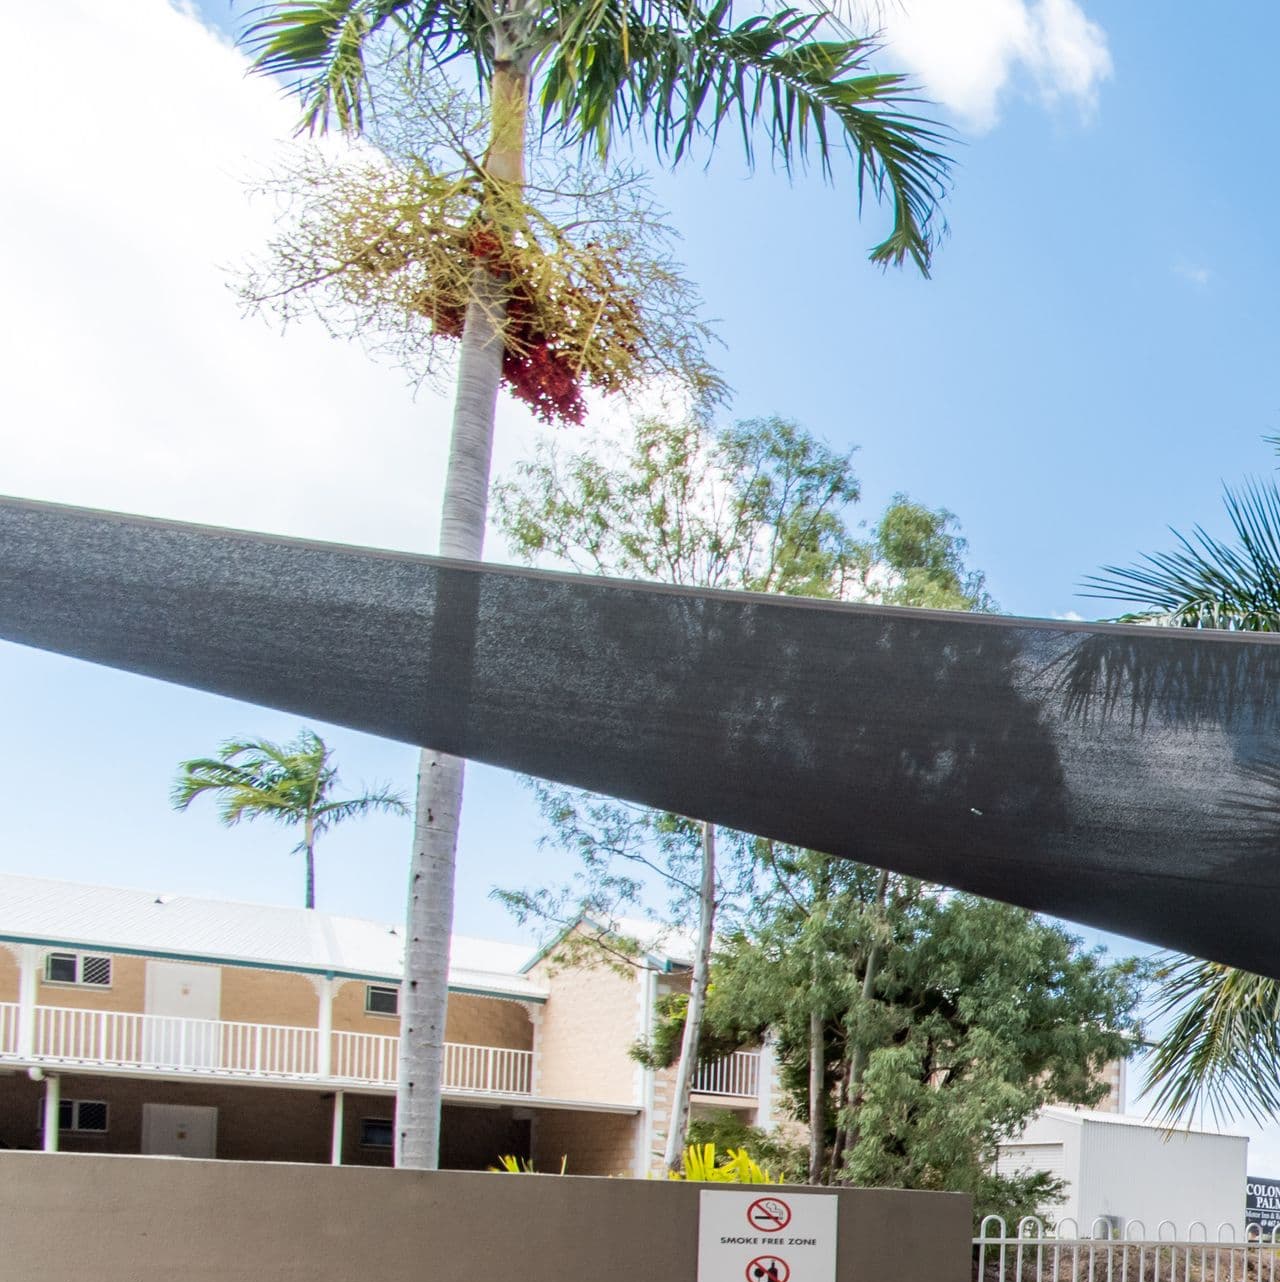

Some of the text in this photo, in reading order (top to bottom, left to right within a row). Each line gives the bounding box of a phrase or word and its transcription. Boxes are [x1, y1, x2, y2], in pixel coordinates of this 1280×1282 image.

[720, 1236, 817, 1246] SMOKE FREE ZONE
